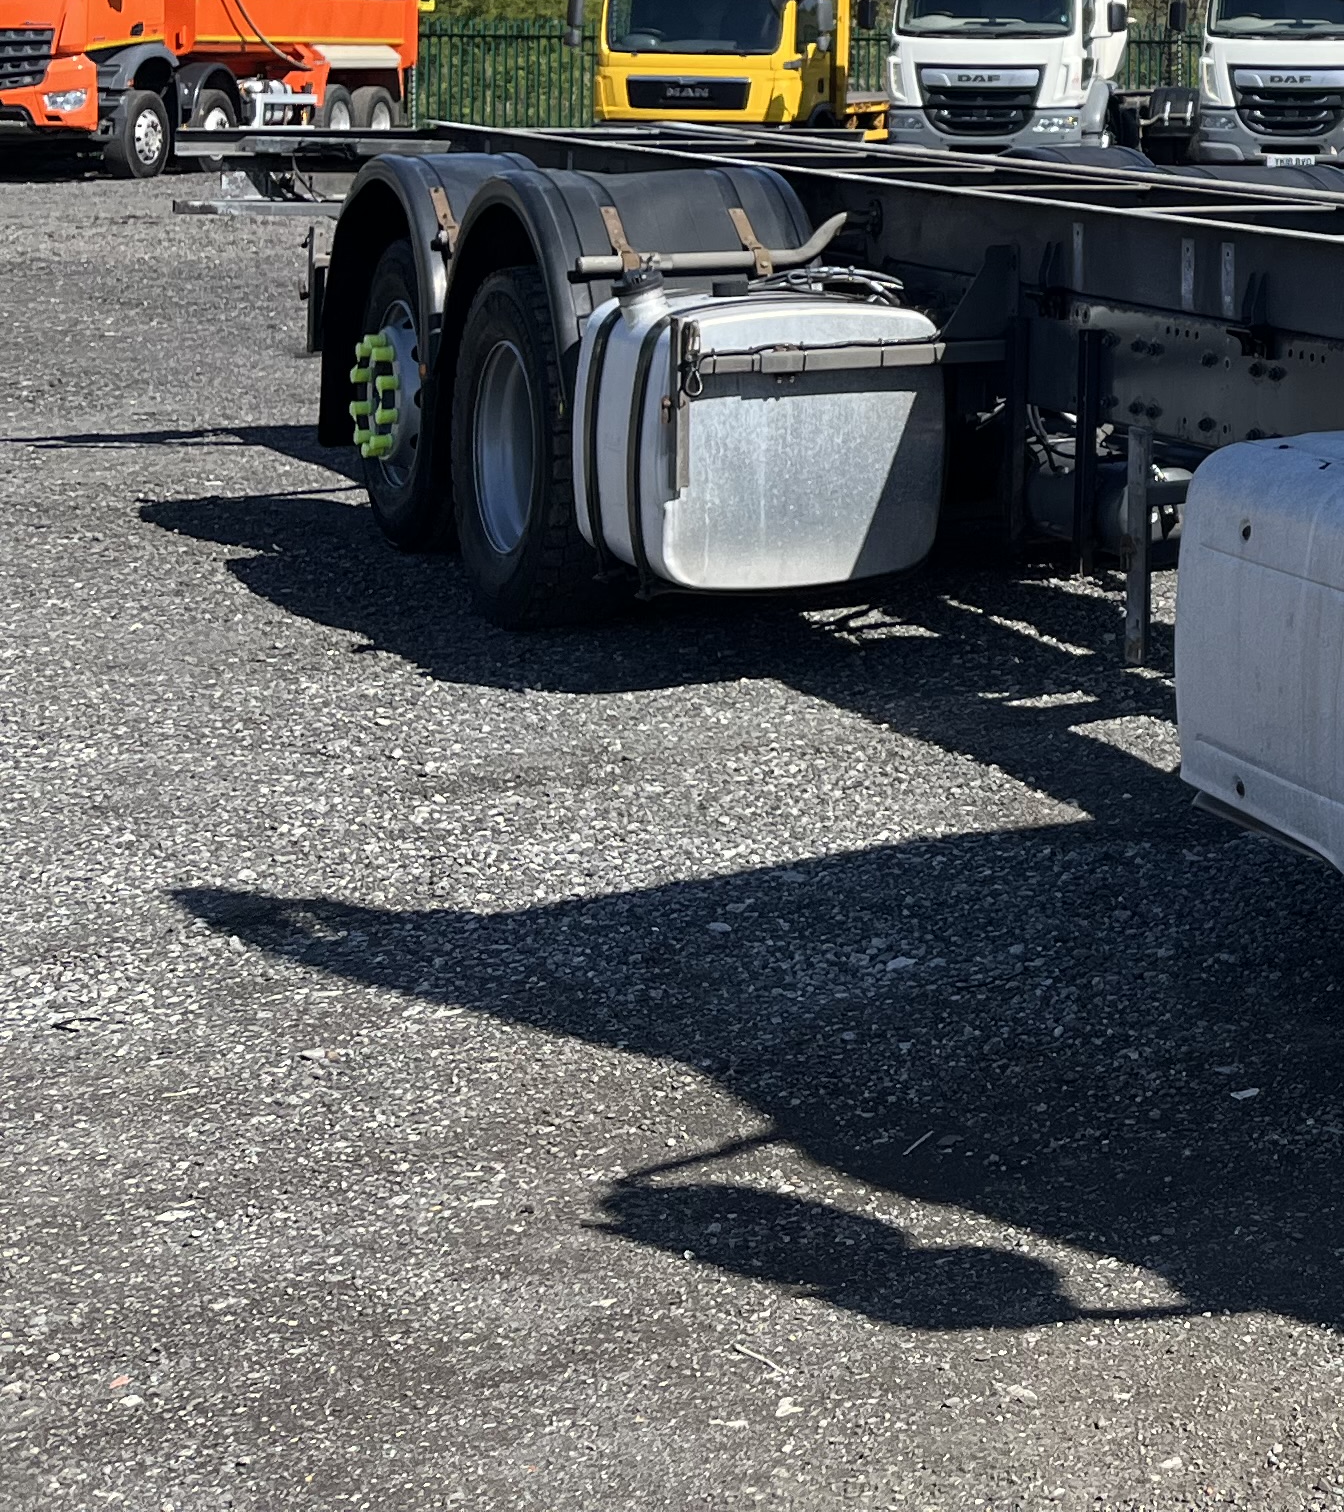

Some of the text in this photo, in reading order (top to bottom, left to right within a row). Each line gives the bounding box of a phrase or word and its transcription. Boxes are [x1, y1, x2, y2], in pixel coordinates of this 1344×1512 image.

[957, 74, 1001, 83] DAF
[1269, 75, 1312, 84] DAF
[666, 87, 710, 98] MAN
